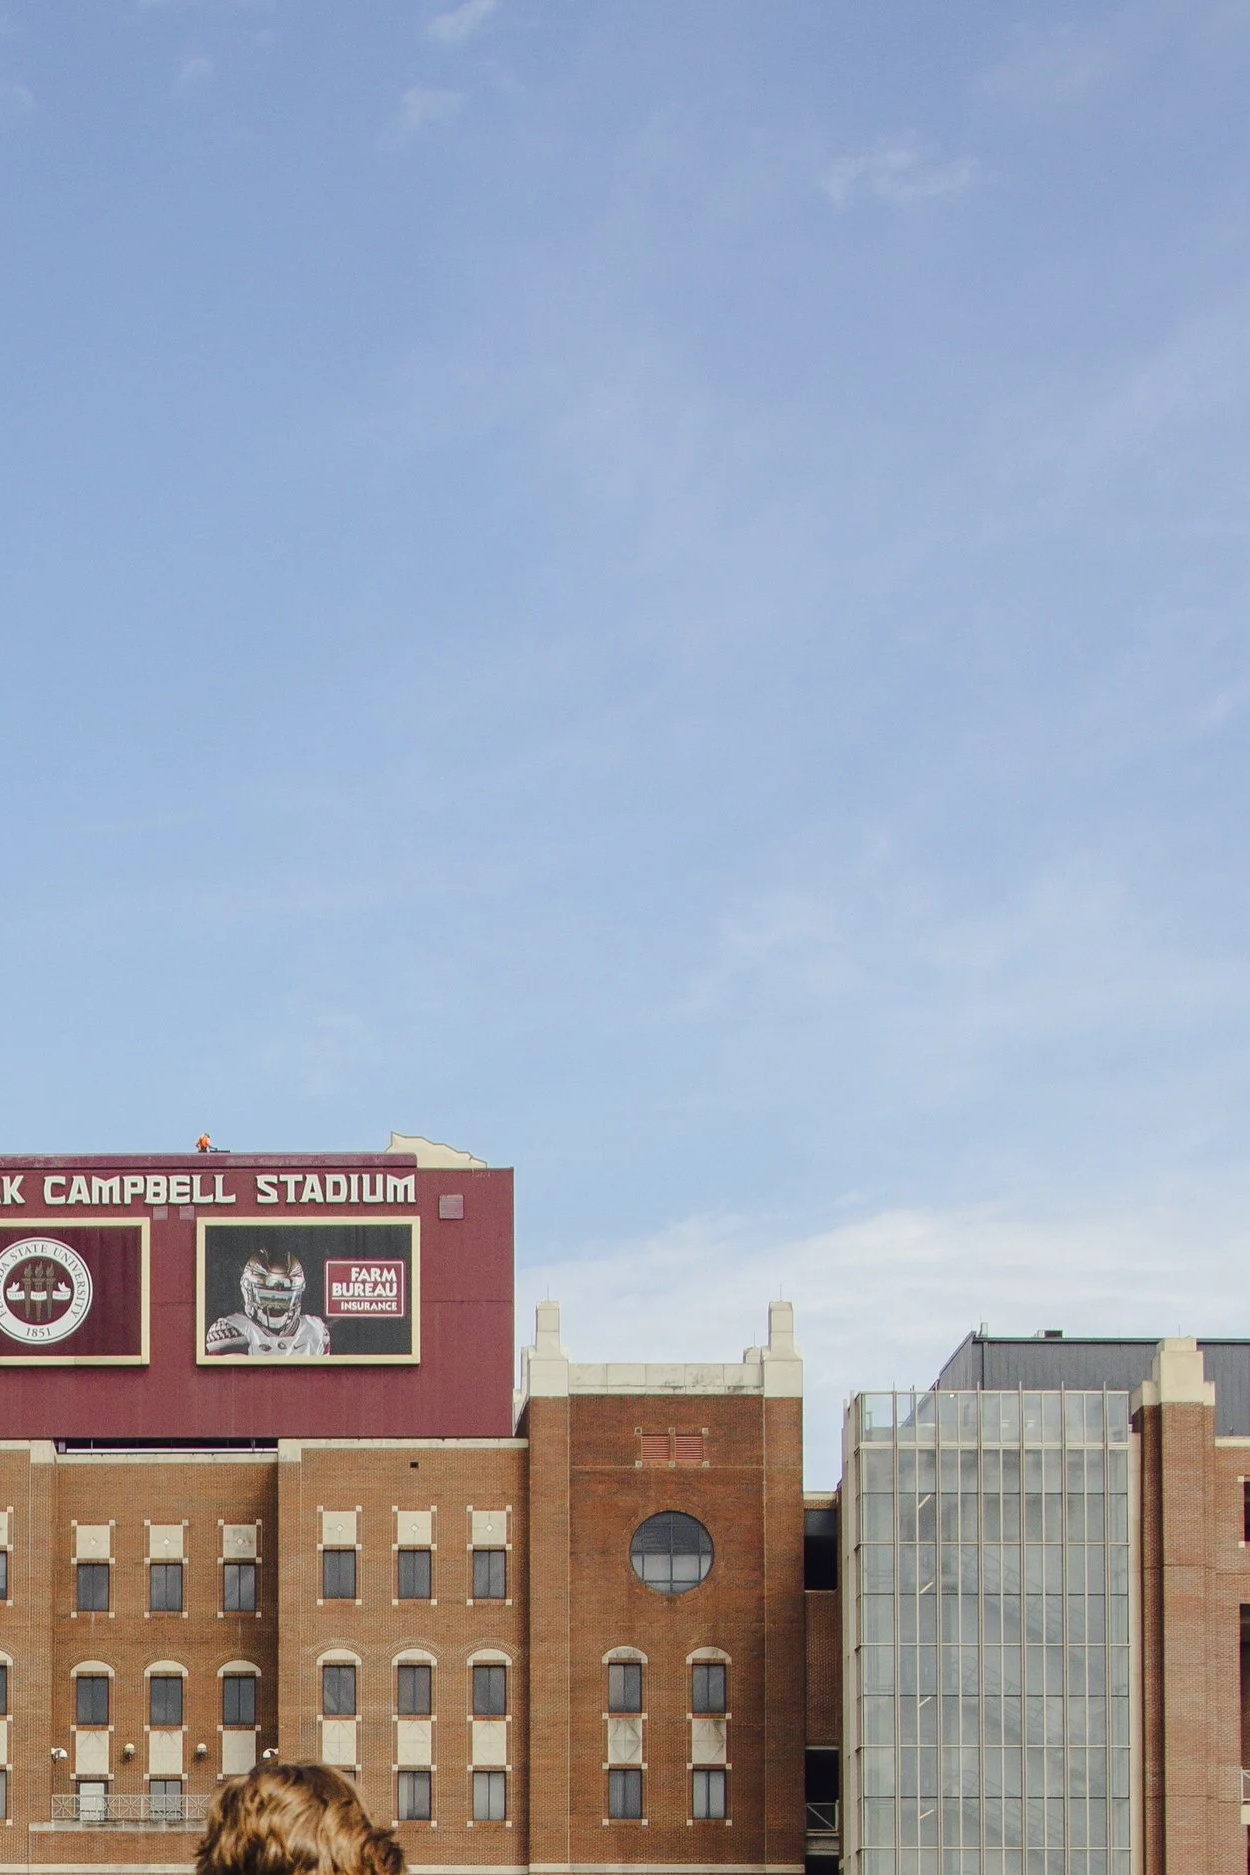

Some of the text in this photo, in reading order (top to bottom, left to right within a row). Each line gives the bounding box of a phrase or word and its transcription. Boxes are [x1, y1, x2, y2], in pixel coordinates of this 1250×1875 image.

[43, 1173, 237, 1206] CAMPBELL
[255, 1173, 417, 1204] STADIUM
[9, 1243, 49, 1262] STATE
[52, 1246, 86, 1319] UNIVERSITY
[350, 1267, 397, 1282] FARM
[331, 1281, 398, 1297] BUREAU
[340, 1301, 398, 1311] INSURANCE
[25, 1326, 52, 1338] 1851
